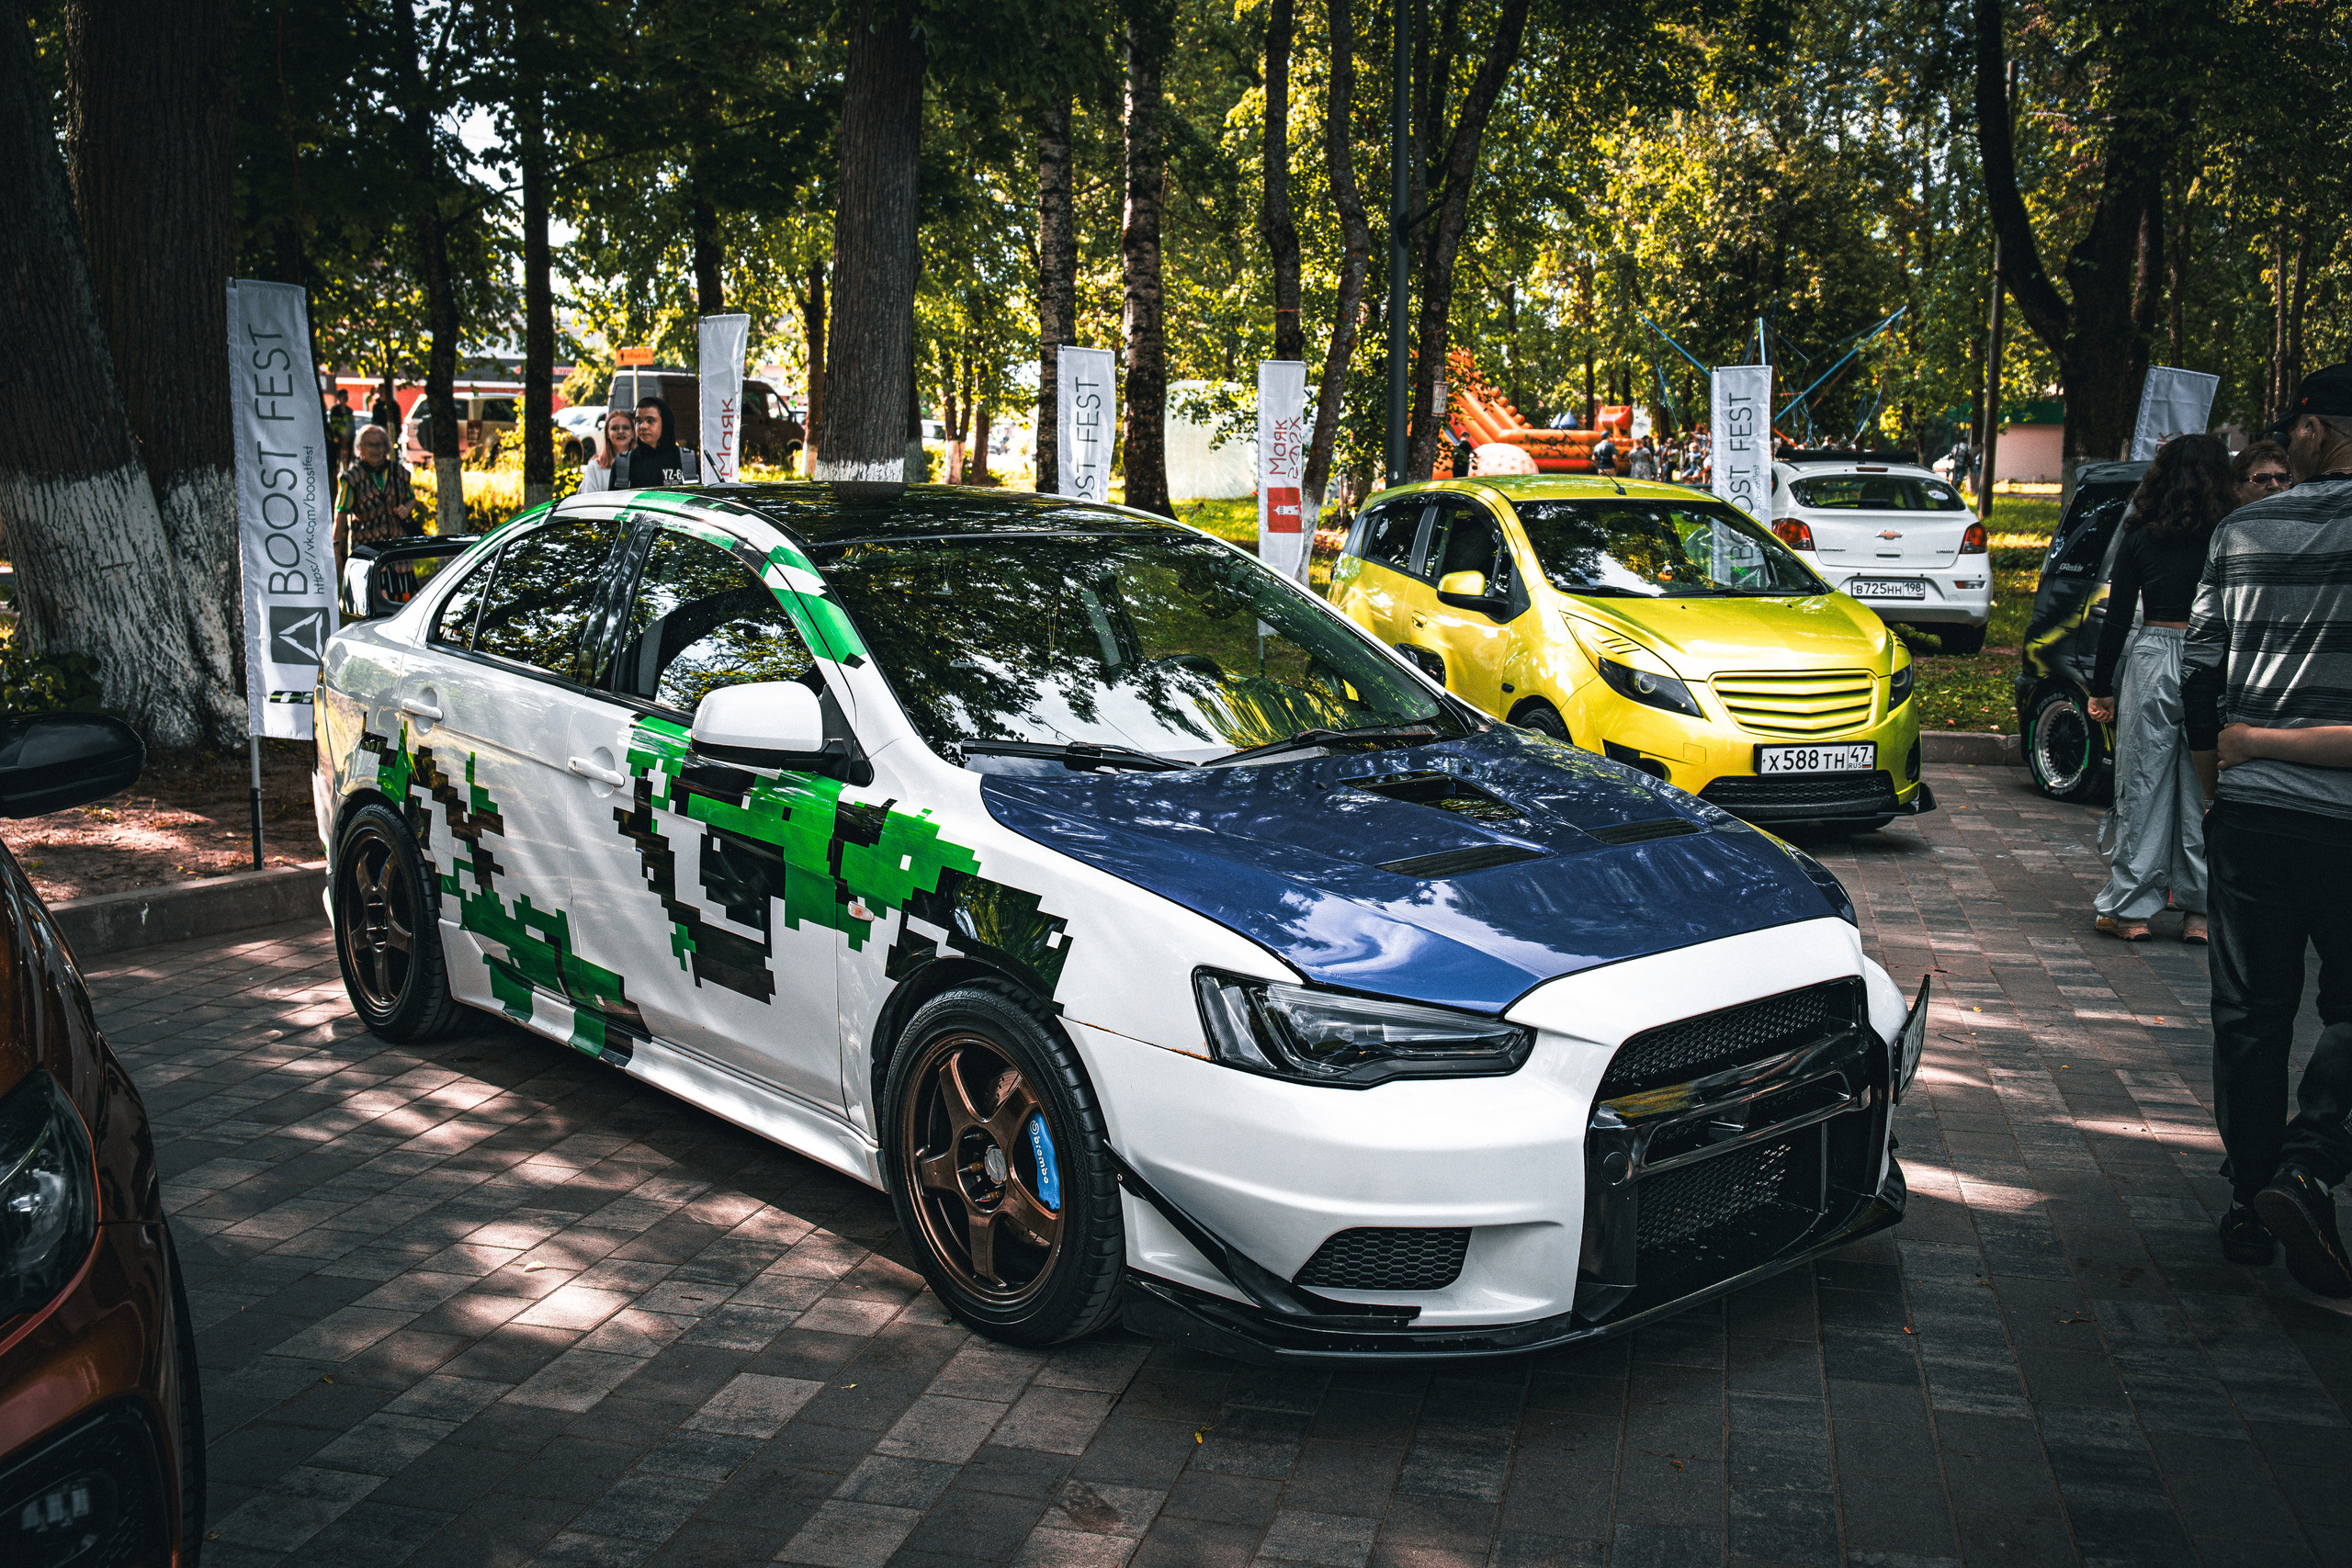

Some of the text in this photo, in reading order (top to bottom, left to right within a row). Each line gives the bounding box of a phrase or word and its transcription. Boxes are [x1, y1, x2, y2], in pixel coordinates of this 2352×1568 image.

[716, 398, 735, 478] Маяк
[1075, 376, 1102, 443] FEST
[1728, 392, 1753, 451] FEST
[247, 322, 309, 595] BOOST FEST
[1268, 419, 1288, 475] Маяк
[302, 445, 325, 595] https://vk.com/boostfest
[1850, 746, 1870, 762] 47
[1033, 1135, 1049, 1184] brembo
